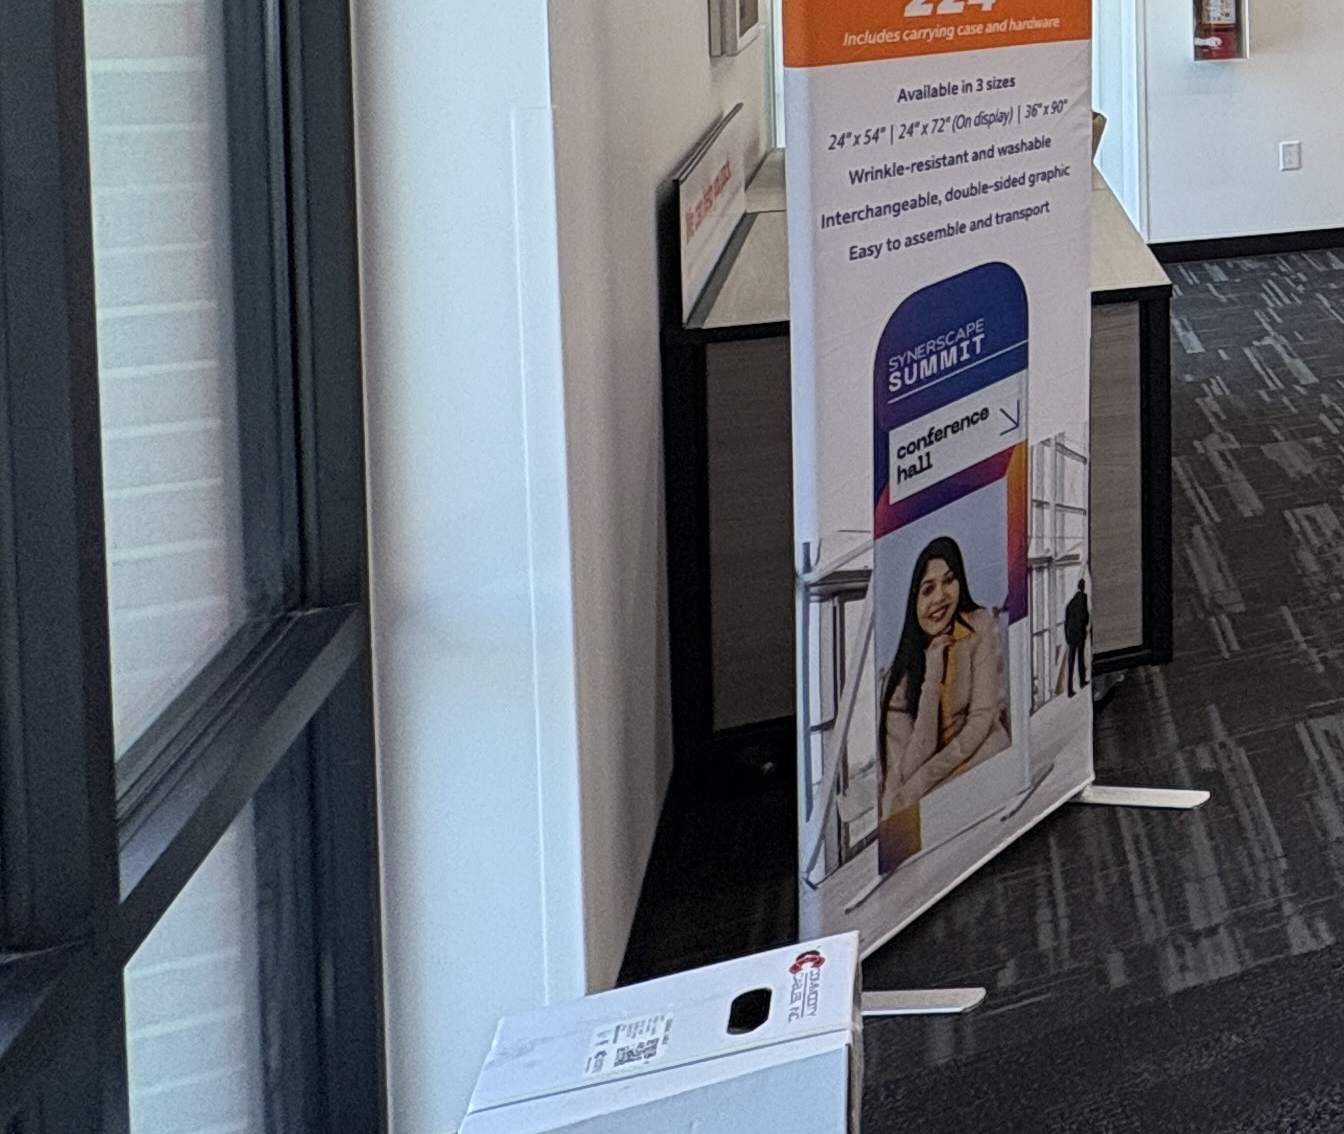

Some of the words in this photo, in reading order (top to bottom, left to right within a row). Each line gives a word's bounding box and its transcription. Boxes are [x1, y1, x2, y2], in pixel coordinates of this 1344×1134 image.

[843, 30, 900, 46] Includes
[902, 24, 955, 43] carrying
[957, 23, 983, 36] case
[985, 20, 1007, 33] and
[1008, 16, 1060, 32] hardware
[897, 82, 958, 103] Available
[961, 80, 973, 94] in
[975, 78, 984, 91] 3
[986, 75, 1016, 90] sizes
[852, 135, 862, 147] x
[921, 124, 929, 135] x
[952, 114, 972, 133] (On
[973, 106, 1013, 131] display)
[1043, 104, 1051, 115] x
[849, 152, 969, 185] Wrinkle-resistant
[971, 144, 995, 162] and
[997, 135, 1052, 157] washable
[821, 192, 942, 229] Interchangeable,
[944, 172, 1026, 203] double-sided
[1028, 163, 1070, 188] graphic
[849, 241, 883, 261] Easy
[886, 238, 901, 251] to
[904, 221, 967, 248] assemble
[969, 215, 993, 232] and
[995, 201, 1050, 225] transport
[888, 318, 985, 372] SYNERSCAPE
[888, 334, 985, 392] SUMMIT
[896, 407, 990, 460] conference
[896, 452, 933, 485] hall
